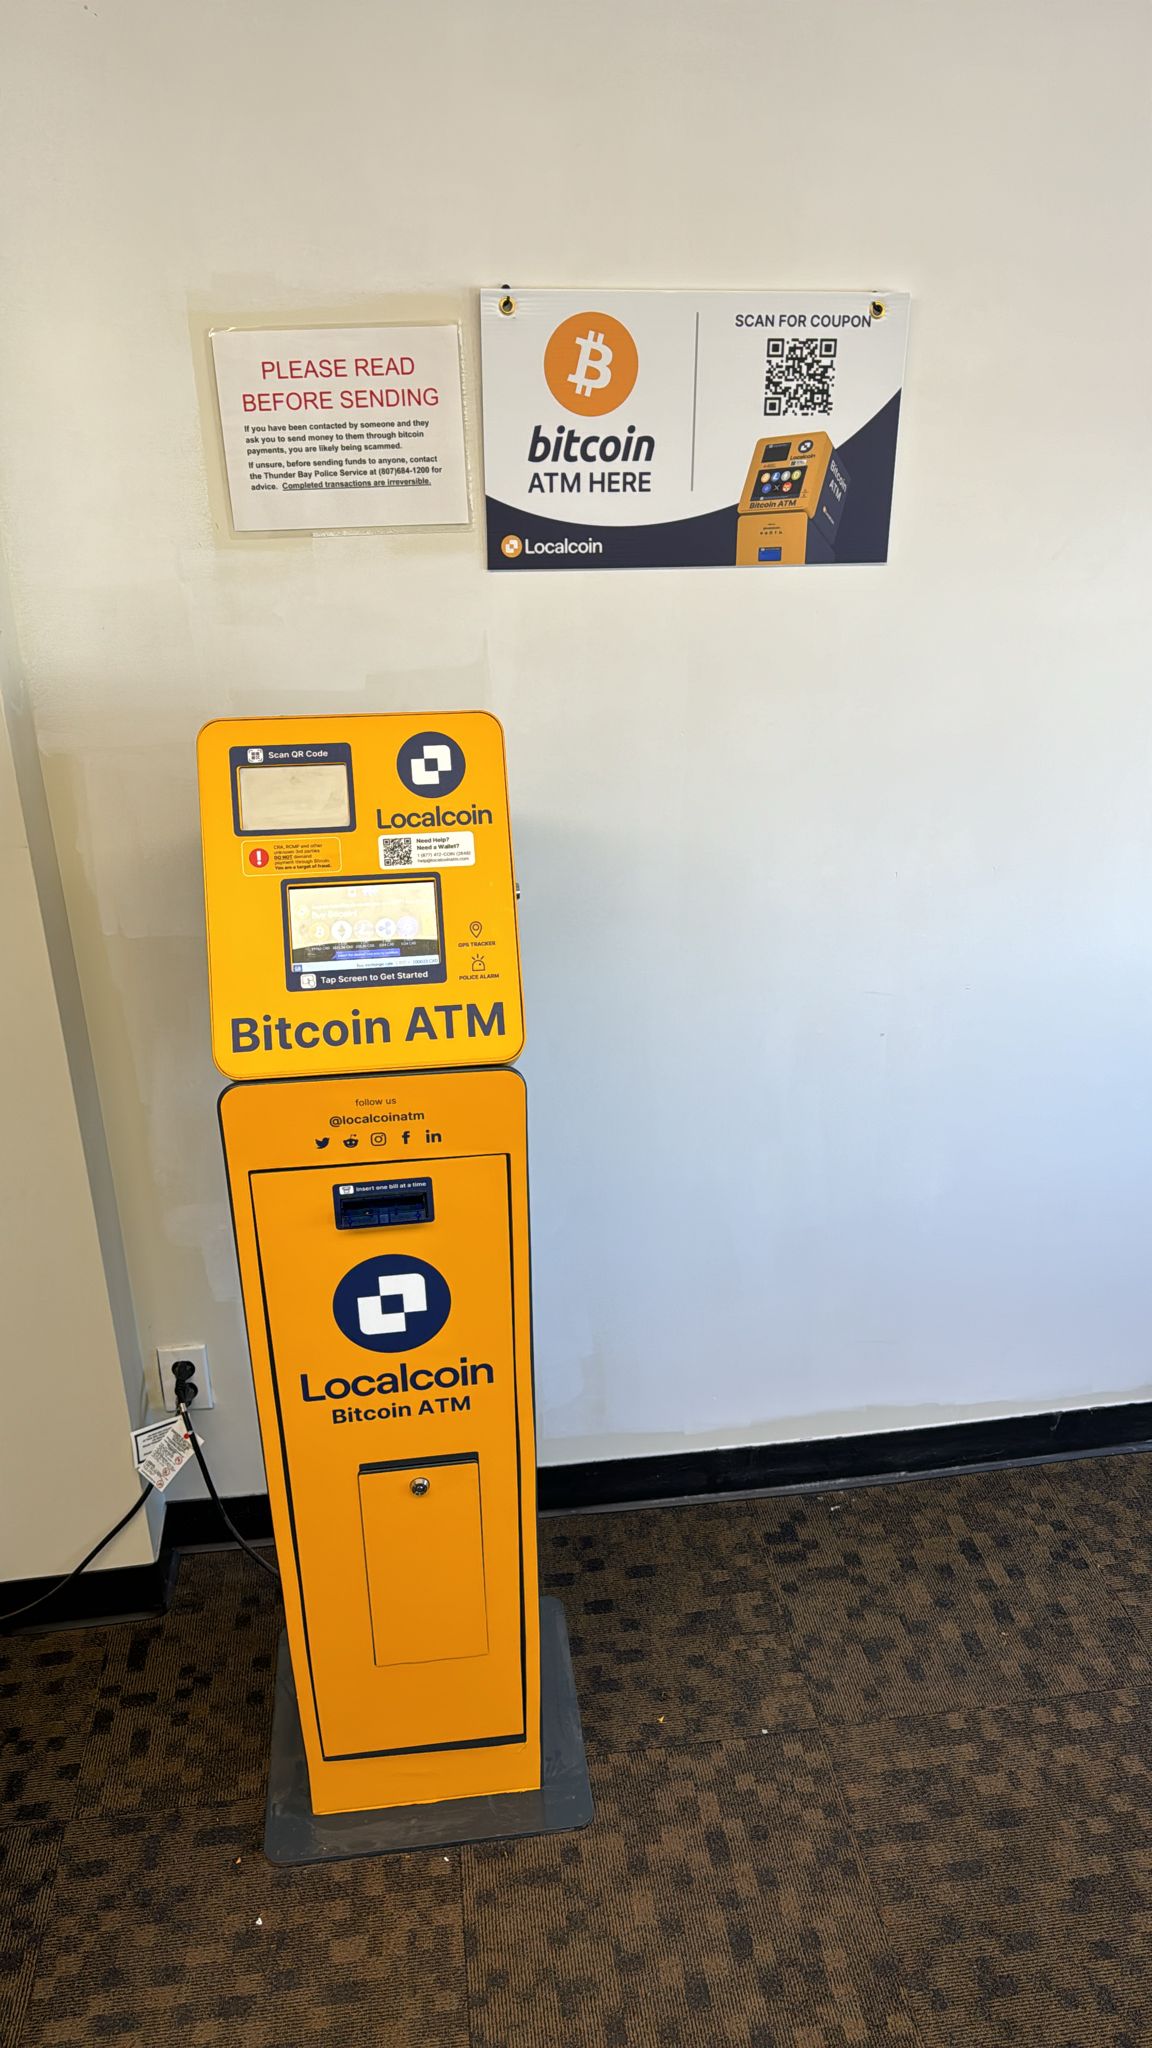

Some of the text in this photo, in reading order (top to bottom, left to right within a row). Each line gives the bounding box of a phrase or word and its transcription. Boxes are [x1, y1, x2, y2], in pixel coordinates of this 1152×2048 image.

[735, 315, 871, 328] SCAN FOR COUPON
[261, 357, 415, 379] PLEASE READ
[242, 388, 439, 412] BEFORE SENDING
[251, 426, 266, 434] you
[309, 422, 347, 430] contacted
[349, 422, 358, 430] by
[413, 419, 429, 428] they
[308, 434, 334, 442] money
[366, 432, 396, 440] through
[527, 425, 655, 463] bitcoin
[247, 447, 287, 456] payments,
[319, 444, 339, 453] likely
[341, 443, 362, 452] being
[287, 459, 311, 468] before
[313, 459, 343, 468] sending
[298, 471, 313, 479] Bay
[314, 469, 338, 477] Police
[282, 481, 323, 490] Completed
[325, 480, 372, 488] transactions
[387, 478, 431, 486] irreversible.
[527, 472, 651, 494] ATM HERE
[750, 501, 776, 509] Bitcoin
[525, 537, 603, 555] Localcoin
[376, 804, 493, 829] Localcoin
[321, 977, 337, 985] Tap
[339, 975, 368, 983] Screen
[380, 973, 395, 981] Get
[397, 971, 429, 979] Started
[231, 1002, 506, 1054] Bitcoin ATM
[356, 1099, 383, 1107] follow
[329, 1112, 425, 1127] @localcoinatm
[301, 1357, 494, 1403] Localcoin
[332, 1396, 471, 1425] Bitcoin ATM
